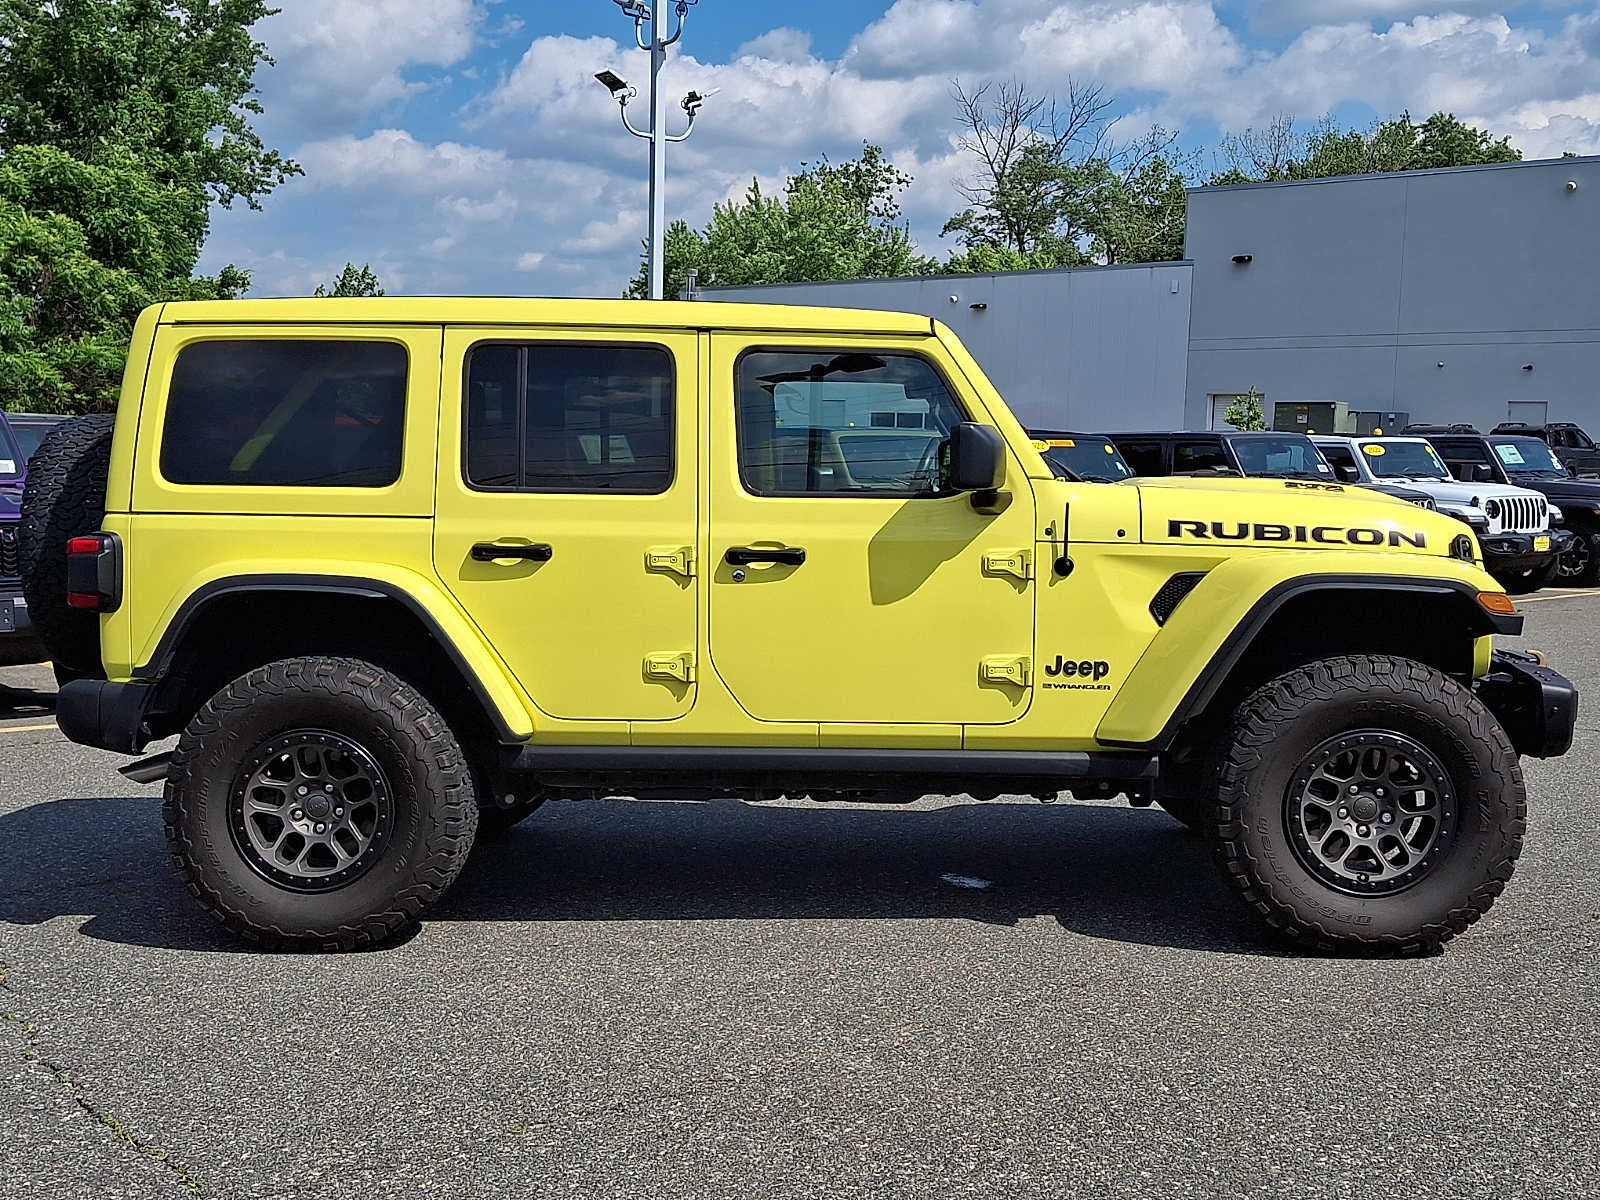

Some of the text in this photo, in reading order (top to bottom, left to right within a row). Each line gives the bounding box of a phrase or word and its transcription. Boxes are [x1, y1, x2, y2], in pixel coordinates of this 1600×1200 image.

[1167, 519, 1427, 549] RUBICON
[1045, 655, 1110, 681] Jeep
[1053, 683, 1111, 691] WRANGLER
